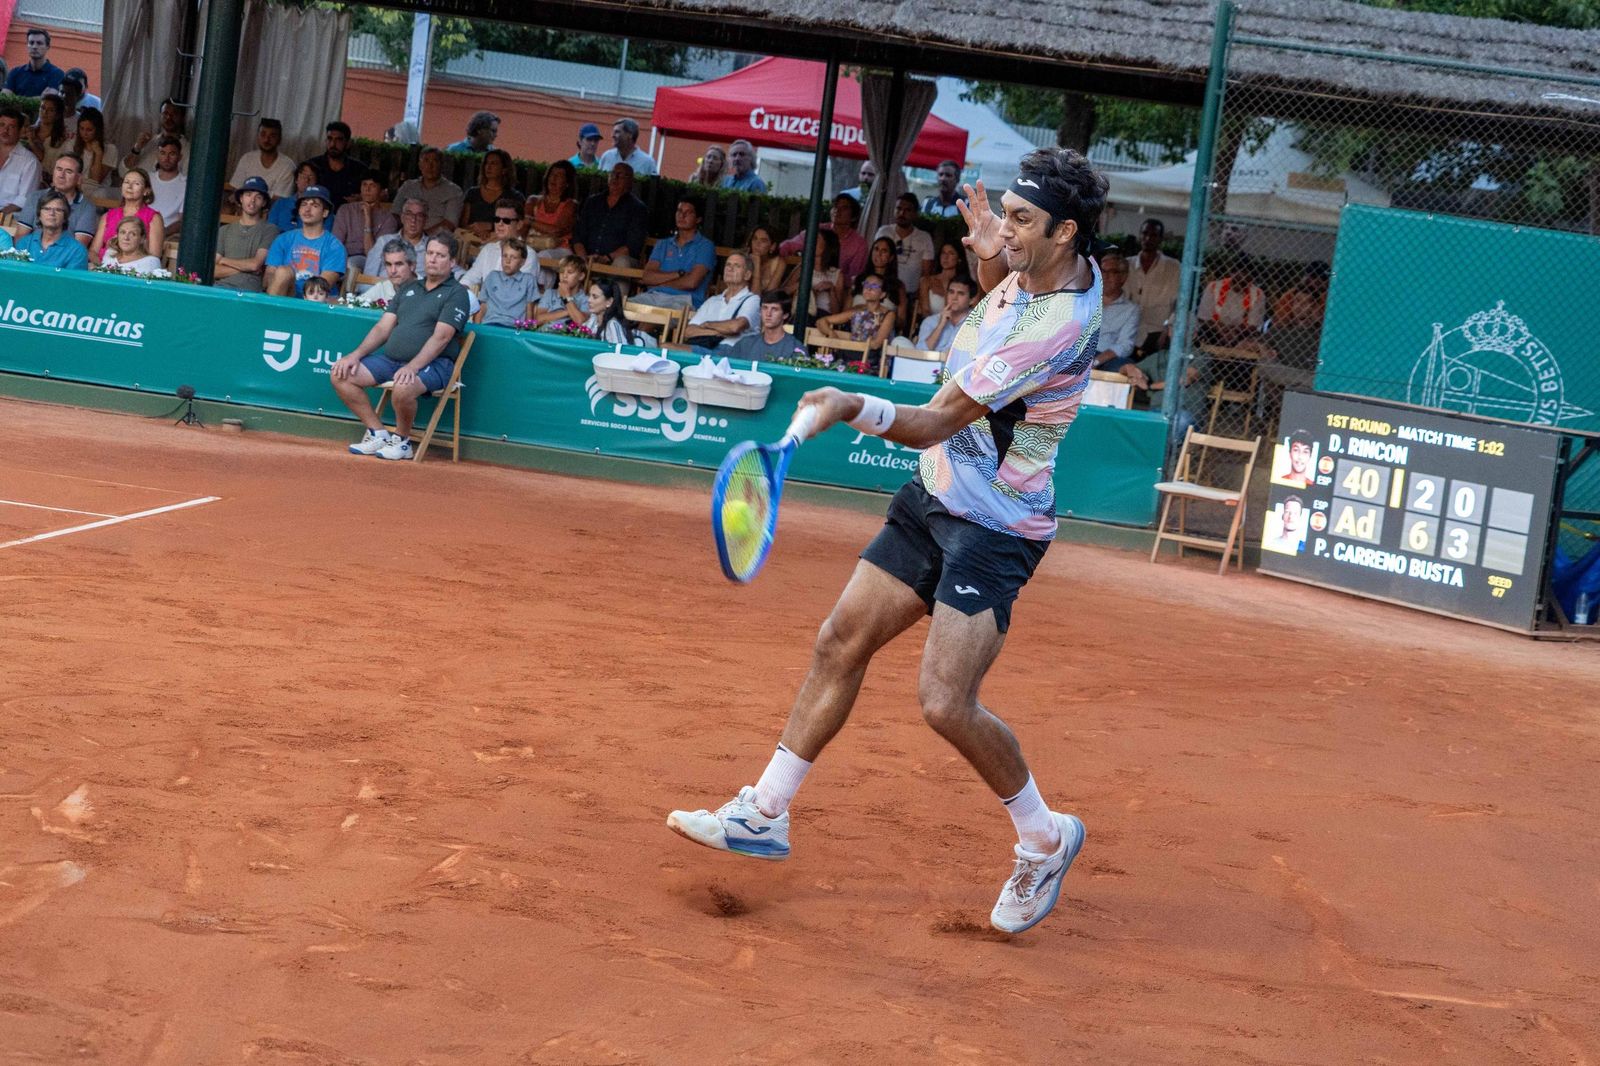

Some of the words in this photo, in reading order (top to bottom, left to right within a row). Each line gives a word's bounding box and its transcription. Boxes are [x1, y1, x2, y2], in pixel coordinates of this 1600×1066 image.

[0, 299, 145, 340] locanarias
[1520, 341, 1558, 393] BETIS
[693, 433, 726, 443] GENERALES
[1326, 414, 1350, 429] 1ST
[1349, 417, 1391, 436] ROUND
[1397, 425, 1444, 446] MATCH
[1443, 433, 1477, 452] TIME
[1476, 439, 1505, 457] 1:02
[1328, 434, 1346, 454] D.
[1347, 437, 1409, 465] RINCON
[1316, 475, 1333, 487] ESP
[1342, 466, 1381, 499] 40
[1413, 479, 1436, 511] 2
[1454, 486, 1476, 518] 0
[1312, 499, 1329, 511] ESP
[1334, 505, 1377, 541] Ad
[1408, 520, 1430, 551] 6
[1446, 527, 1470, 560] 3
[1313, 538, 1331, 559] P.
[1333, 543, 1408, 575] CARRENO
[1408, 557, 1464, 588] BUSTA
[1486, 573, 1513, 589] SEED
